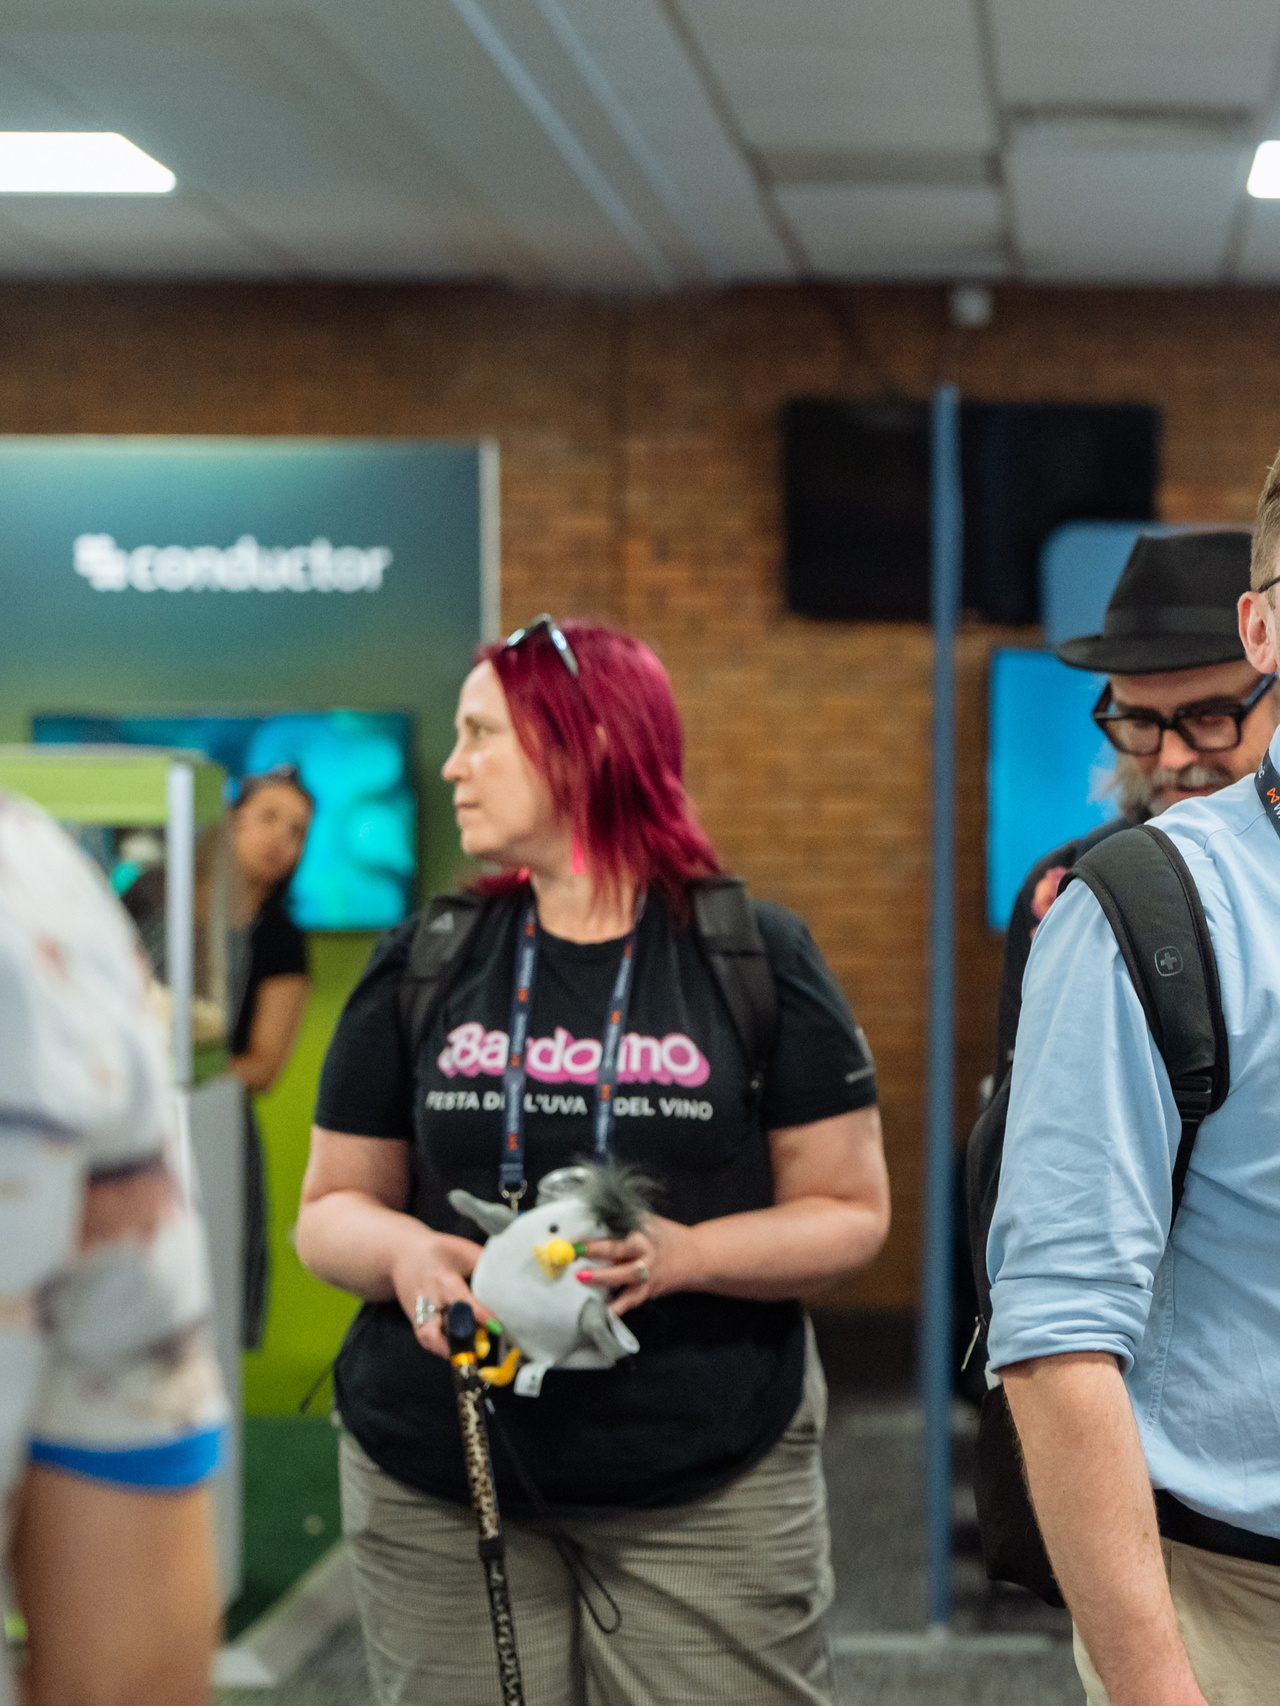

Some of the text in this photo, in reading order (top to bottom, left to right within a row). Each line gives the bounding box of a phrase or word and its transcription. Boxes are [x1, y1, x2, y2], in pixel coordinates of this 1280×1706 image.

[127, 535, 394, 592] conductor
[438, 1022, 706, 1082] Badoino
[426, 1091, 480, 1111] FESTA
[482, 1091, 588, 1115] DL'UVA
[613, 1096, 656, 1117] DEL
[658, 1097, 714, 1121] VINO
